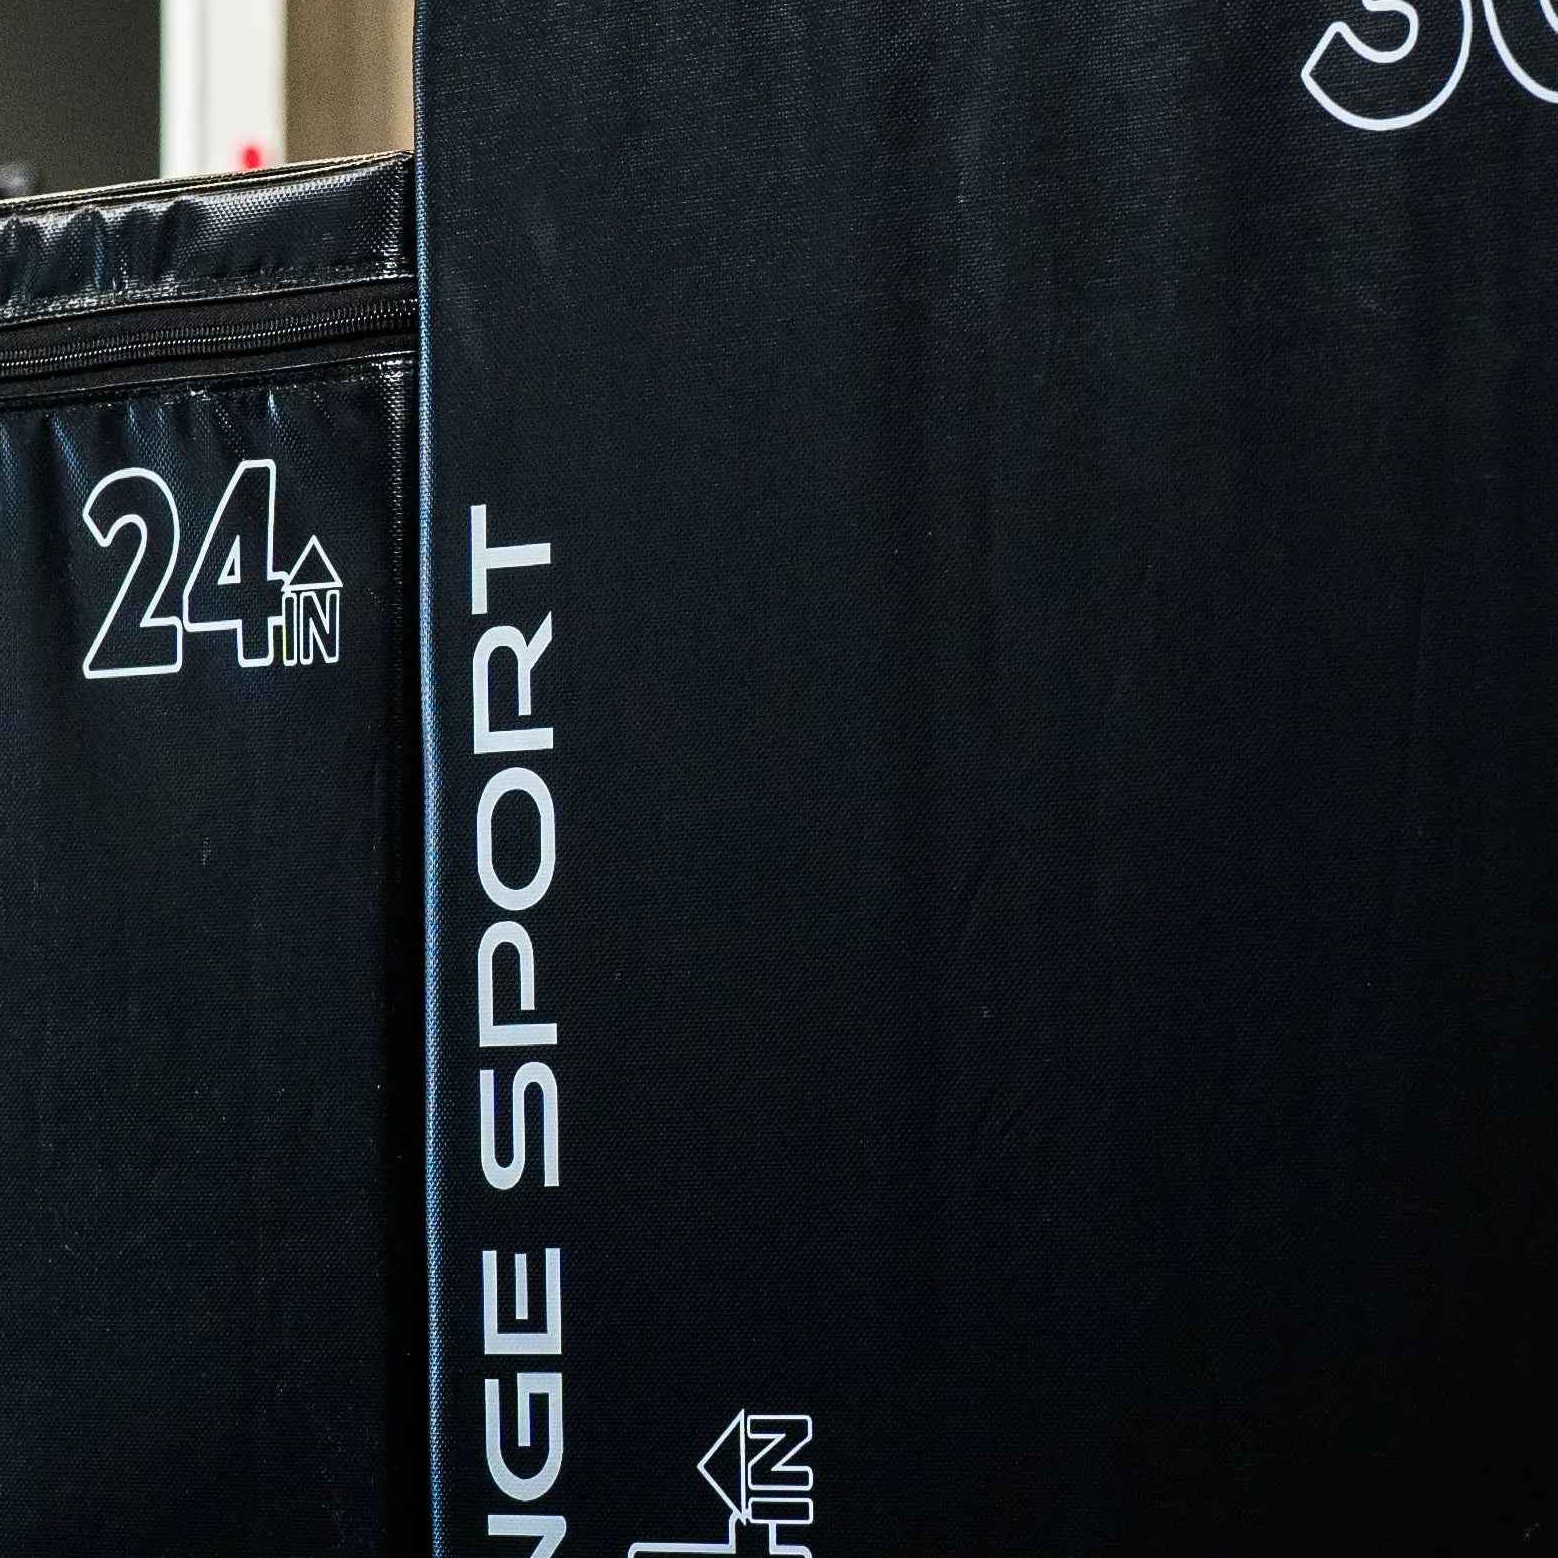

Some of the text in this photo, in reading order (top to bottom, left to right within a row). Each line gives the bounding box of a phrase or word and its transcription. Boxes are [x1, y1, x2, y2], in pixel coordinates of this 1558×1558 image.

[81, 458, 340, 680] 24 IN
[469, 502, 561, 1192] SPORT
[745, 1414, 814, 1525] IN
